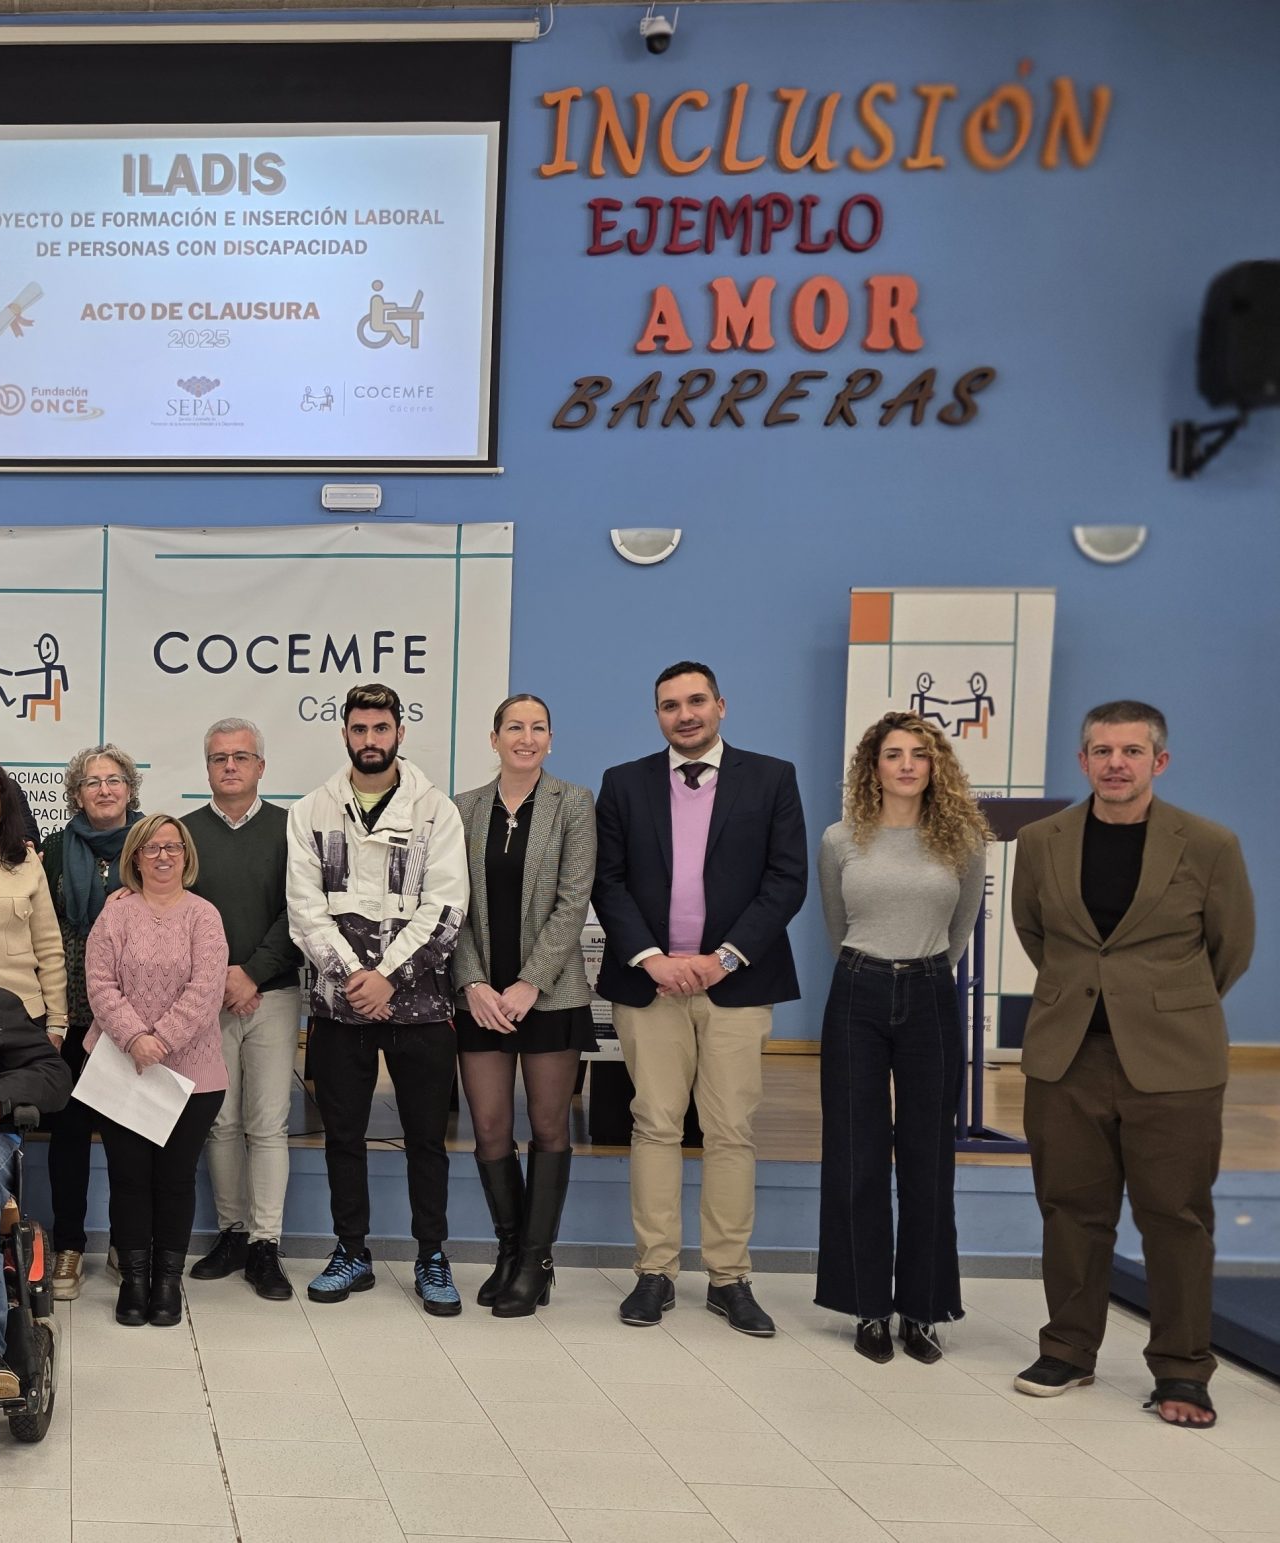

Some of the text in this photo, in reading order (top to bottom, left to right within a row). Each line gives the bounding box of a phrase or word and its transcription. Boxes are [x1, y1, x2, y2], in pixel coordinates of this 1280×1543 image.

[538, 58, 1111, 178] INCLUSIÓN
[123, 152, 287, 197] ILADIS
[70, 211, 96, 227] DE
[101, 207, 217, 227] FORMACIÓN
[223, 210, 236, 226] E
[242, 206, 347, 226] INSERCIÓN
[354, 208, 444, 225] LABORAL
[586, 193, 884, 256] EJEMPLO
[36, 239, 368, 257] DE PERSONAS CON DISCAPACIDAD
[80, 302, 320, 321] ACTO DE CLAUSURA
[635, 275, 924, 354] AMOR
[168, 328, 230, 349] 2025
[31, 386, 88, 397] Fundación
[354, 385, 434, 399] COCEMFE
[552, 366, 997, 430] BARRERAS
[30, 399, 88, 414] ONCE
[166, 399, 230, 416] SEPAD
[153, 630, 427, 675] COCEMFE
